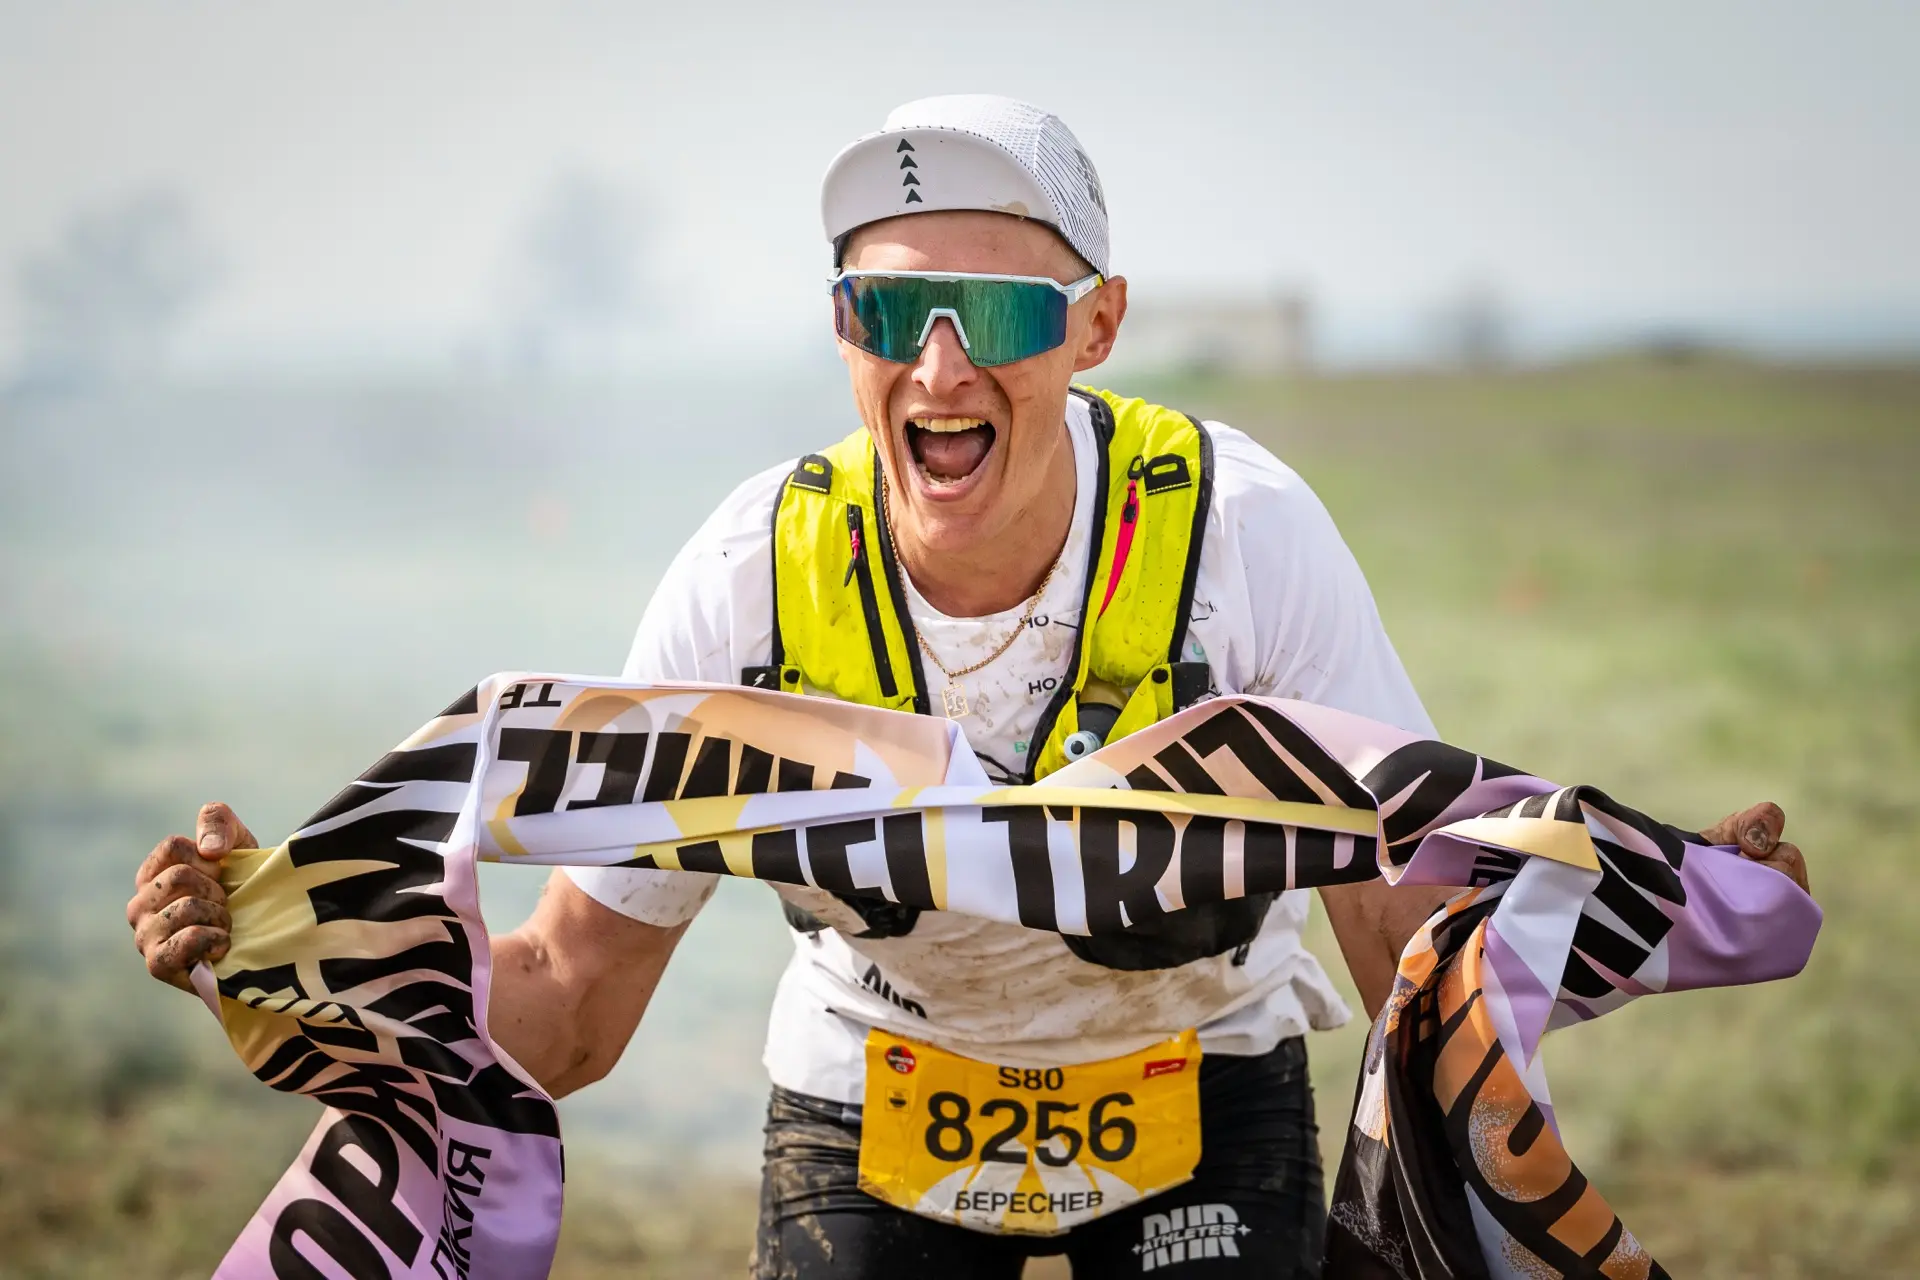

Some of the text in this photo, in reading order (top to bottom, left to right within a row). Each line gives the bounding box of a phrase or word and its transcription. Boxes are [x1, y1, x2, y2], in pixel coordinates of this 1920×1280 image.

[997, 1066, 1064, 1091] S80
[924, 1092, 1137, 1168] 8256
[954, 1190, 1104, 1216] БЕРЕСНЕВ
[1141, 1224, 1236, 1254] ATHLETES
